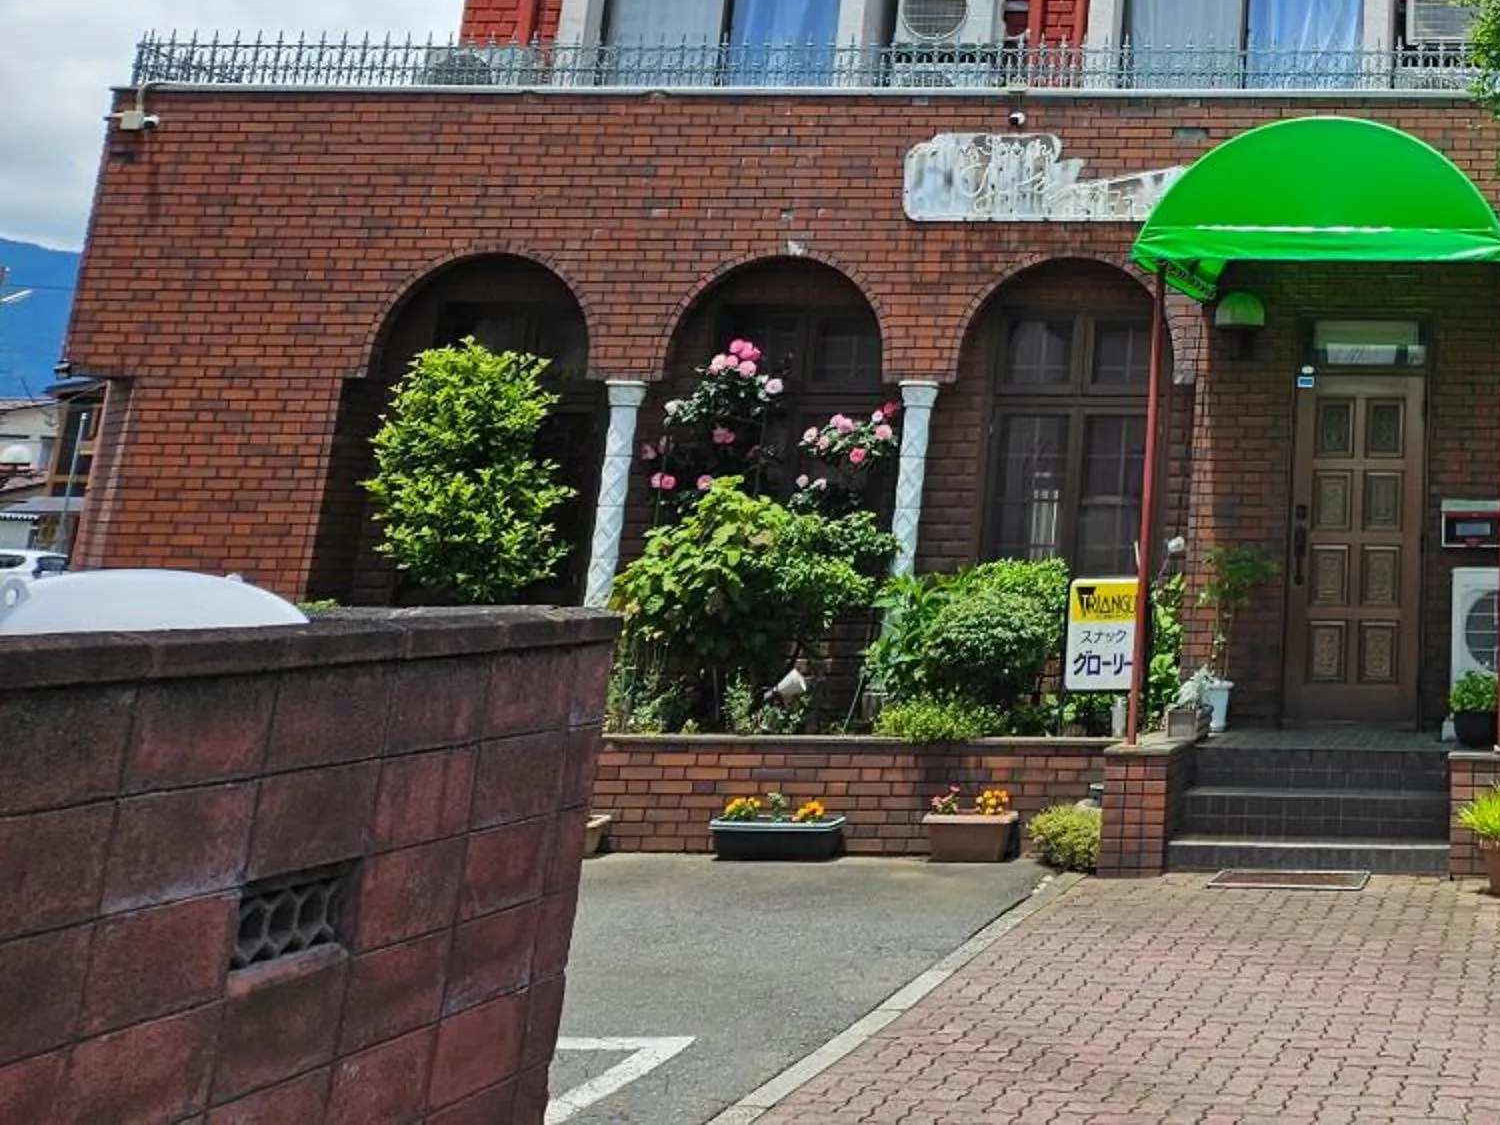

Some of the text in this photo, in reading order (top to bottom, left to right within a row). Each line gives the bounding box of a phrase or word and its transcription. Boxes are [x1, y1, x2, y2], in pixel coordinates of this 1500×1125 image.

[1080, 630, 1127, 644] スナック
[1073, 651, 1133, 676] グローリー
